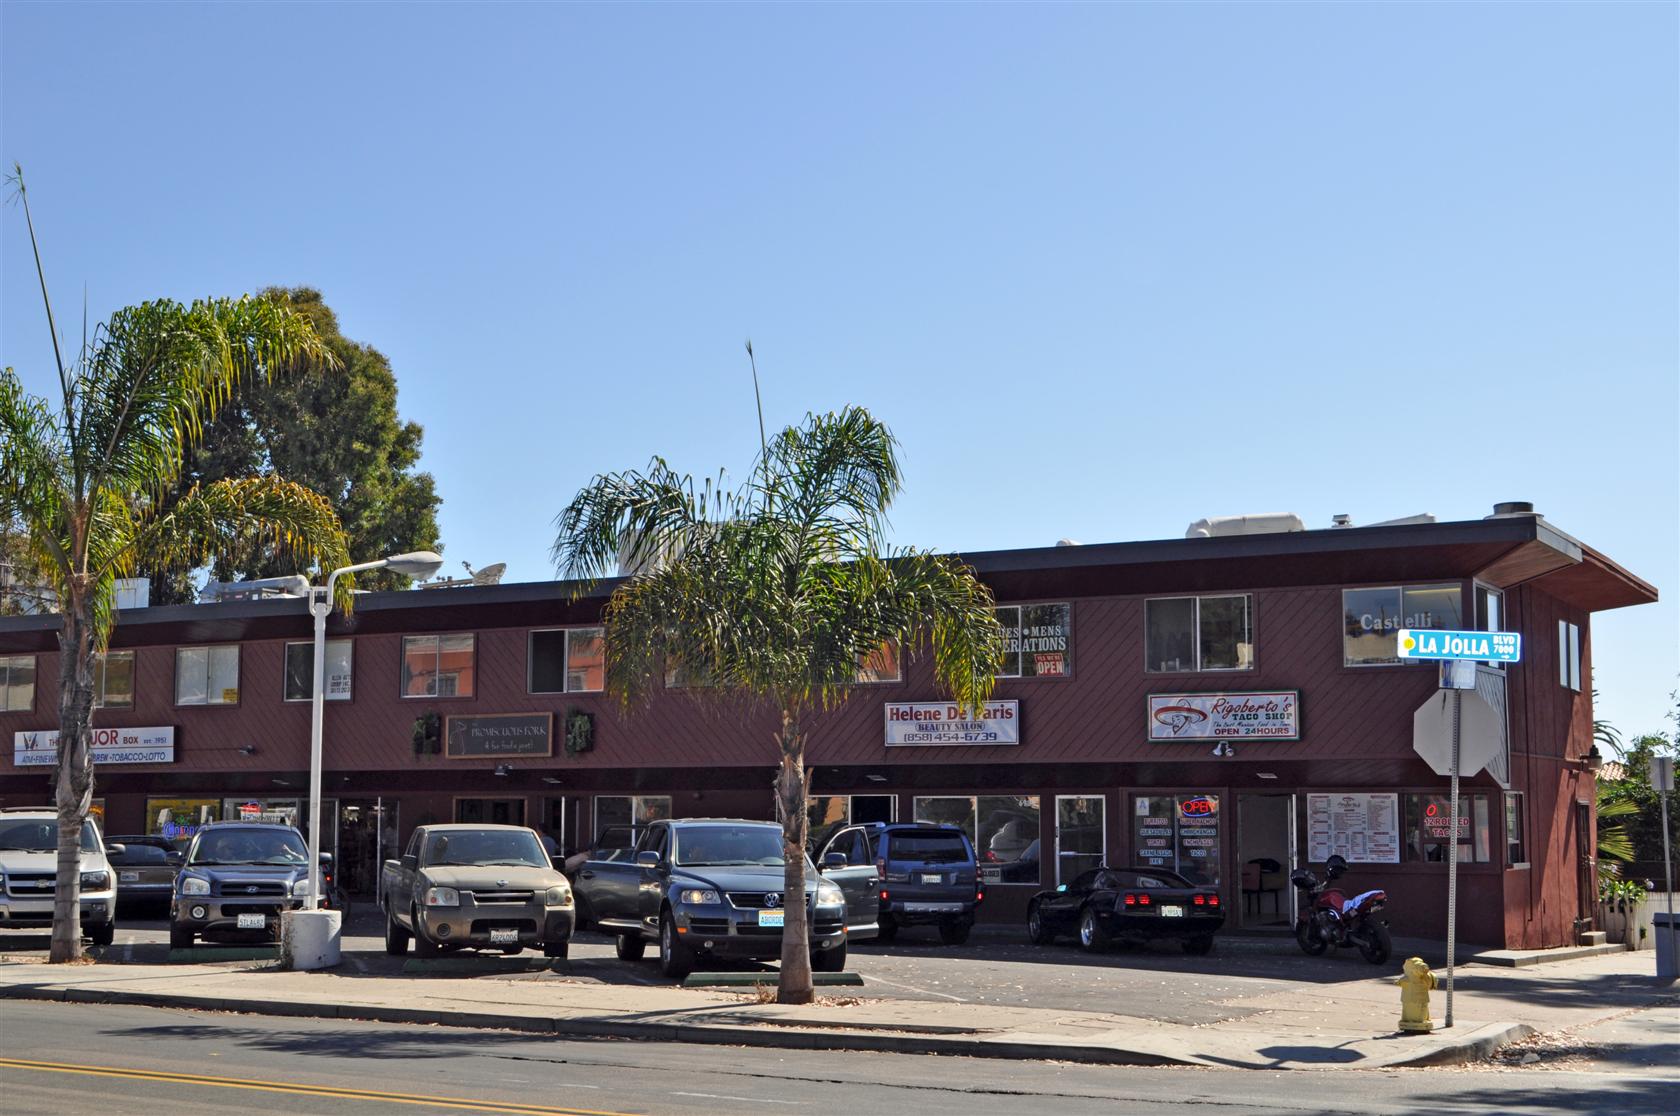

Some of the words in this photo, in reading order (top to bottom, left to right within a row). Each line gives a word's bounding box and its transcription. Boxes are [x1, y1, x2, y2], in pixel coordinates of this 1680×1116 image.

[1360, 613, 1433, 630] Castelli
[1031, 626, 1061, 637] MENS
[1418, 634, 1438, 654] LA
[1441, 635, 1490, 656] JOLLA
[1493, 636, 1515, 645] BLVD
[1493, 645, 1515, 654] 7000
[1038, 661, 1063, 674] OPEN
[889, 706, 942, 721] Helene
[946, 706, 967, 720] De
[977, 704, 1013, 720] aris
[1211, 697, 1292, 719] Rigoberto's
[1231, 713, 1259, 721] TACO
[1265, 712, 1293, 720] SHOP
[524, 726, 547, 735] FORK
[918, 723, 953, 731] BEAUTY
[48, 737, 60, 746] TH
[123, 736, 139, 745] BOX
[1182, 800, 1216, 813] OPEN
[1435, 817, 1469, 826] ROLED
[1433, 828, 1463, 837] TACS
